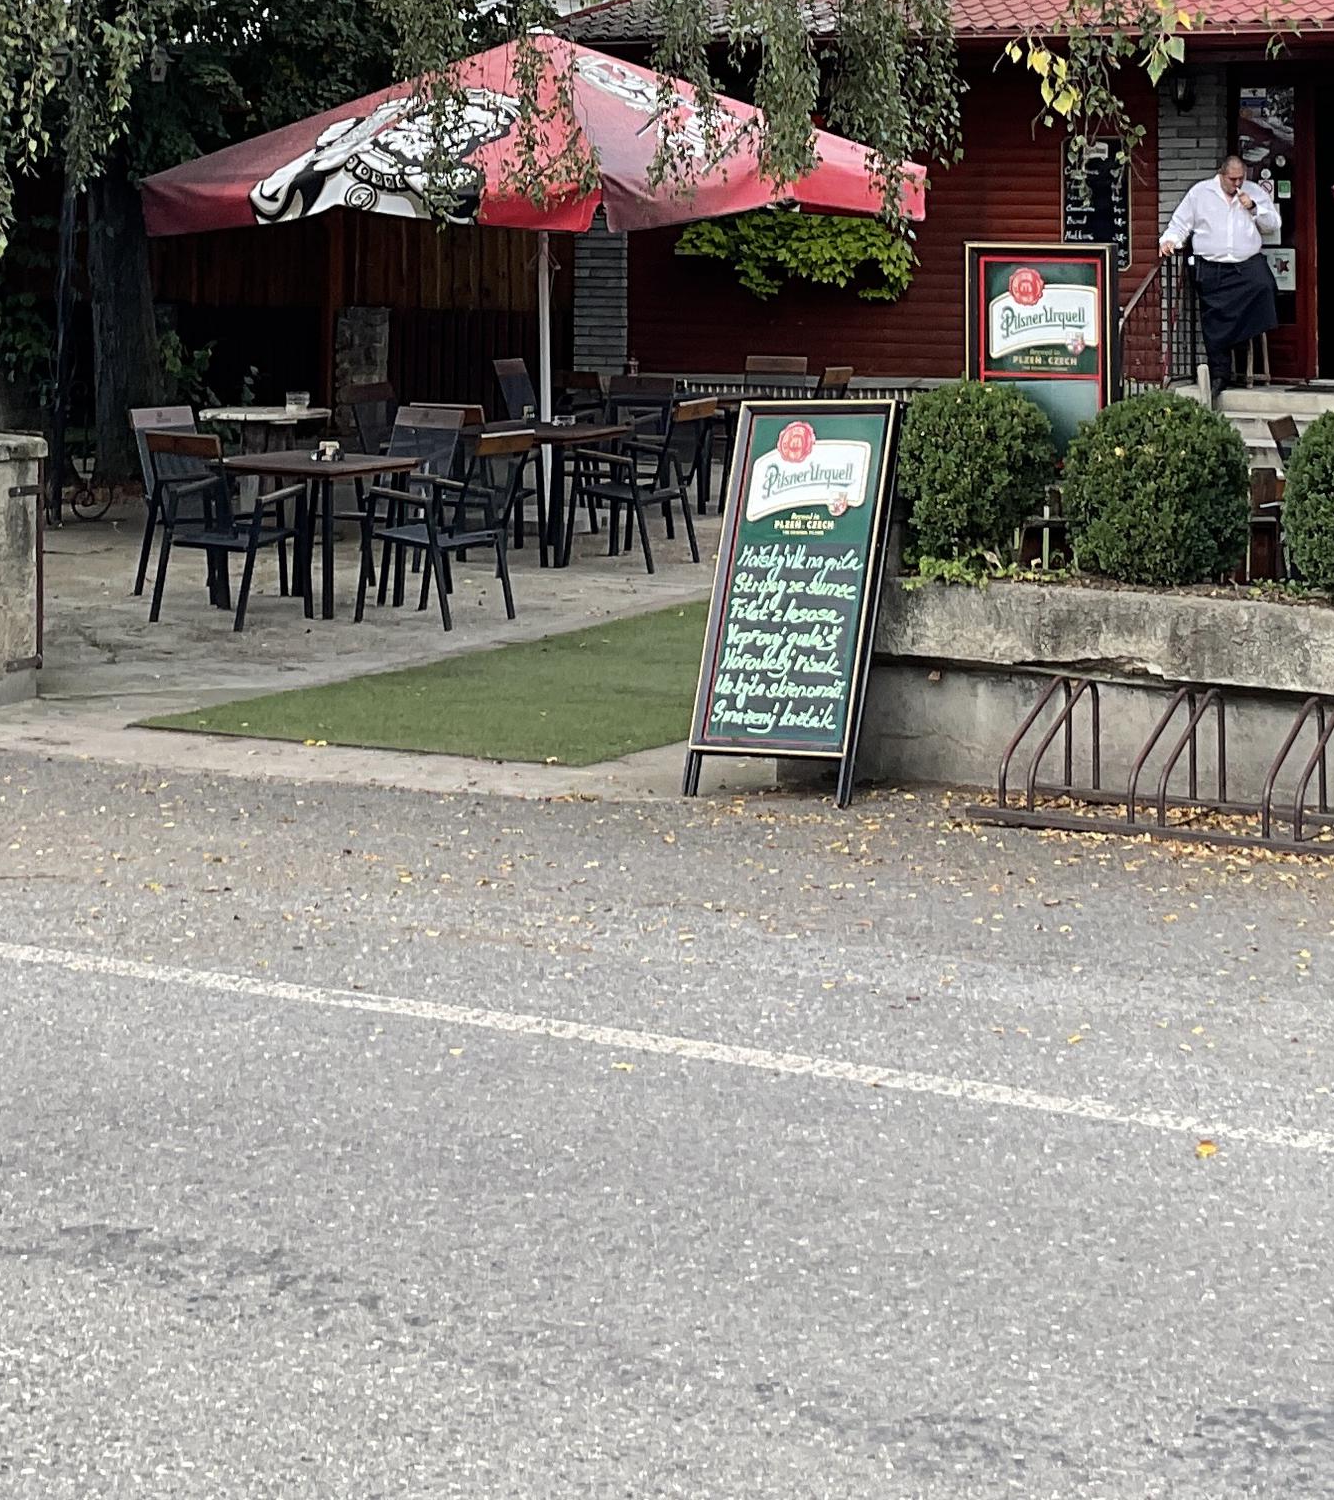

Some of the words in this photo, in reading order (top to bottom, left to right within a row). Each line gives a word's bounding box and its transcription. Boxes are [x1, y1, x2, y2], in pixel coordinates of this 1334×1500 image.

[1000, 306, 1043, 339] Pilsner
[1043, 305, 1085, 330] Urquell
[762, 463, 809, 499] Pilsner
[809, 461, 853, 489] Urquell
